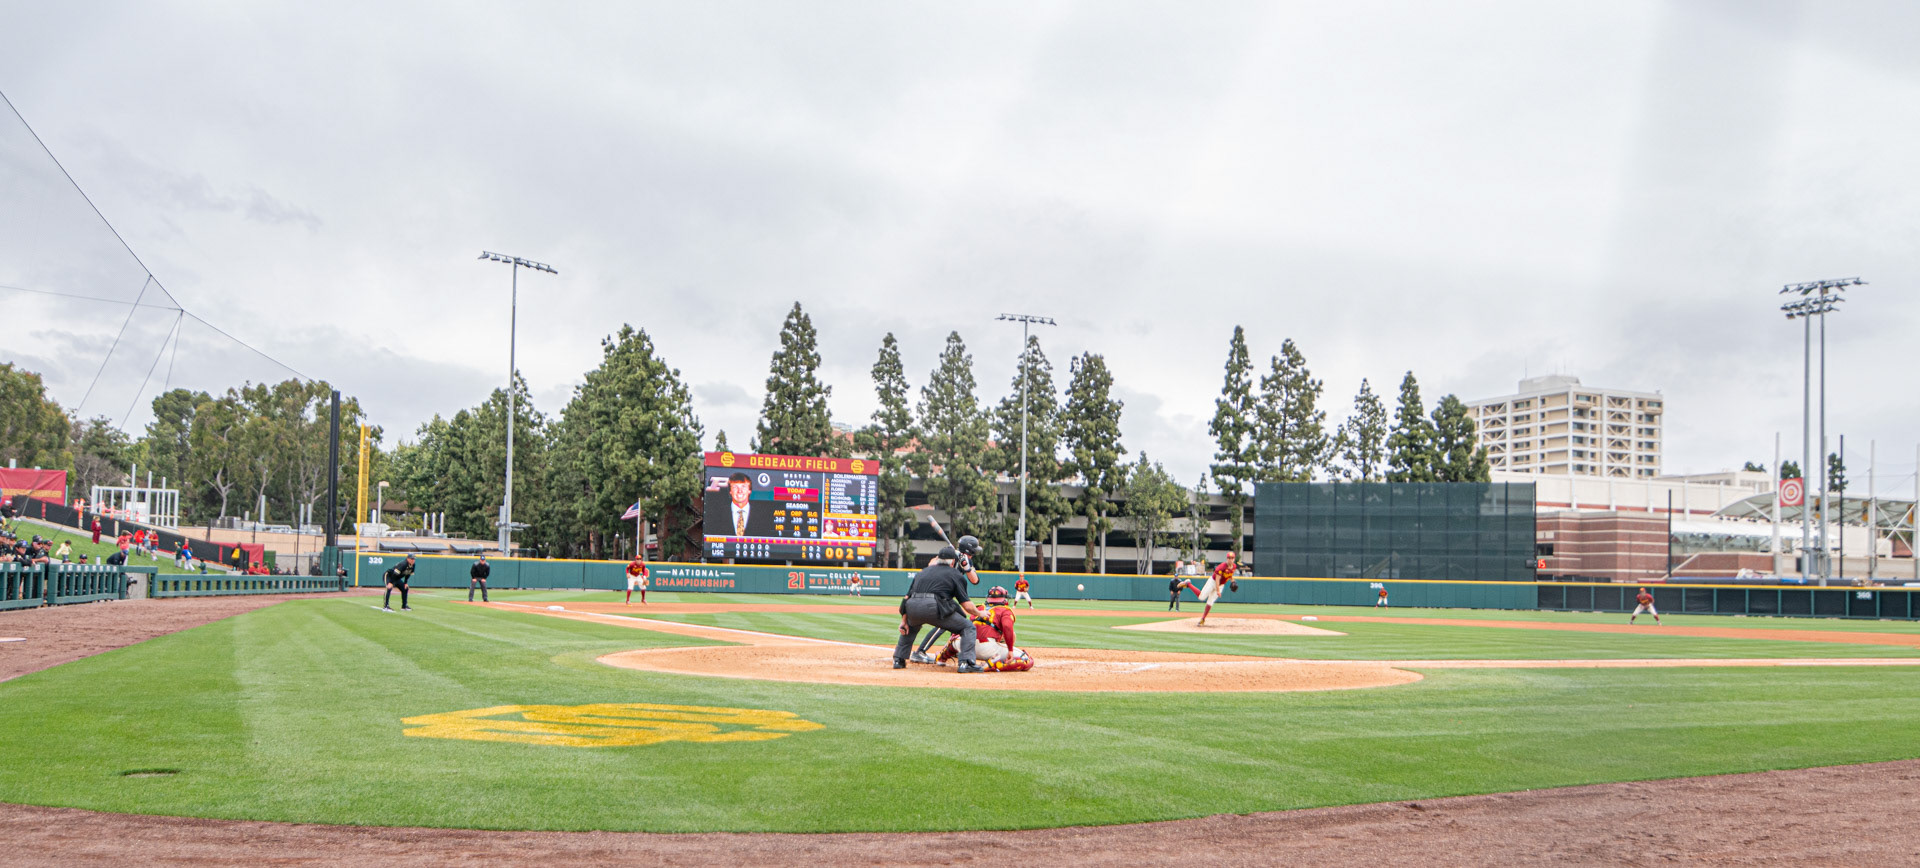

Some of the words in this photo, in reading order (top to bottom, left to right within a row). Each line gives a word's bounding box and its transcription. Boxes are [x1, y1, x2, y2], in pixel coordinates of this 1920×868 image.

[750, 456, 802, 468] DEDEAUX
[806, 459, 837, 470] FIELD
[1538, 559, 1546, 569] 15
[672, 569, 719, 577] NATIONAL
[656, 578, 735, 588] CHAMPIONSHIPS
[788, 572, 804, 589] 21
